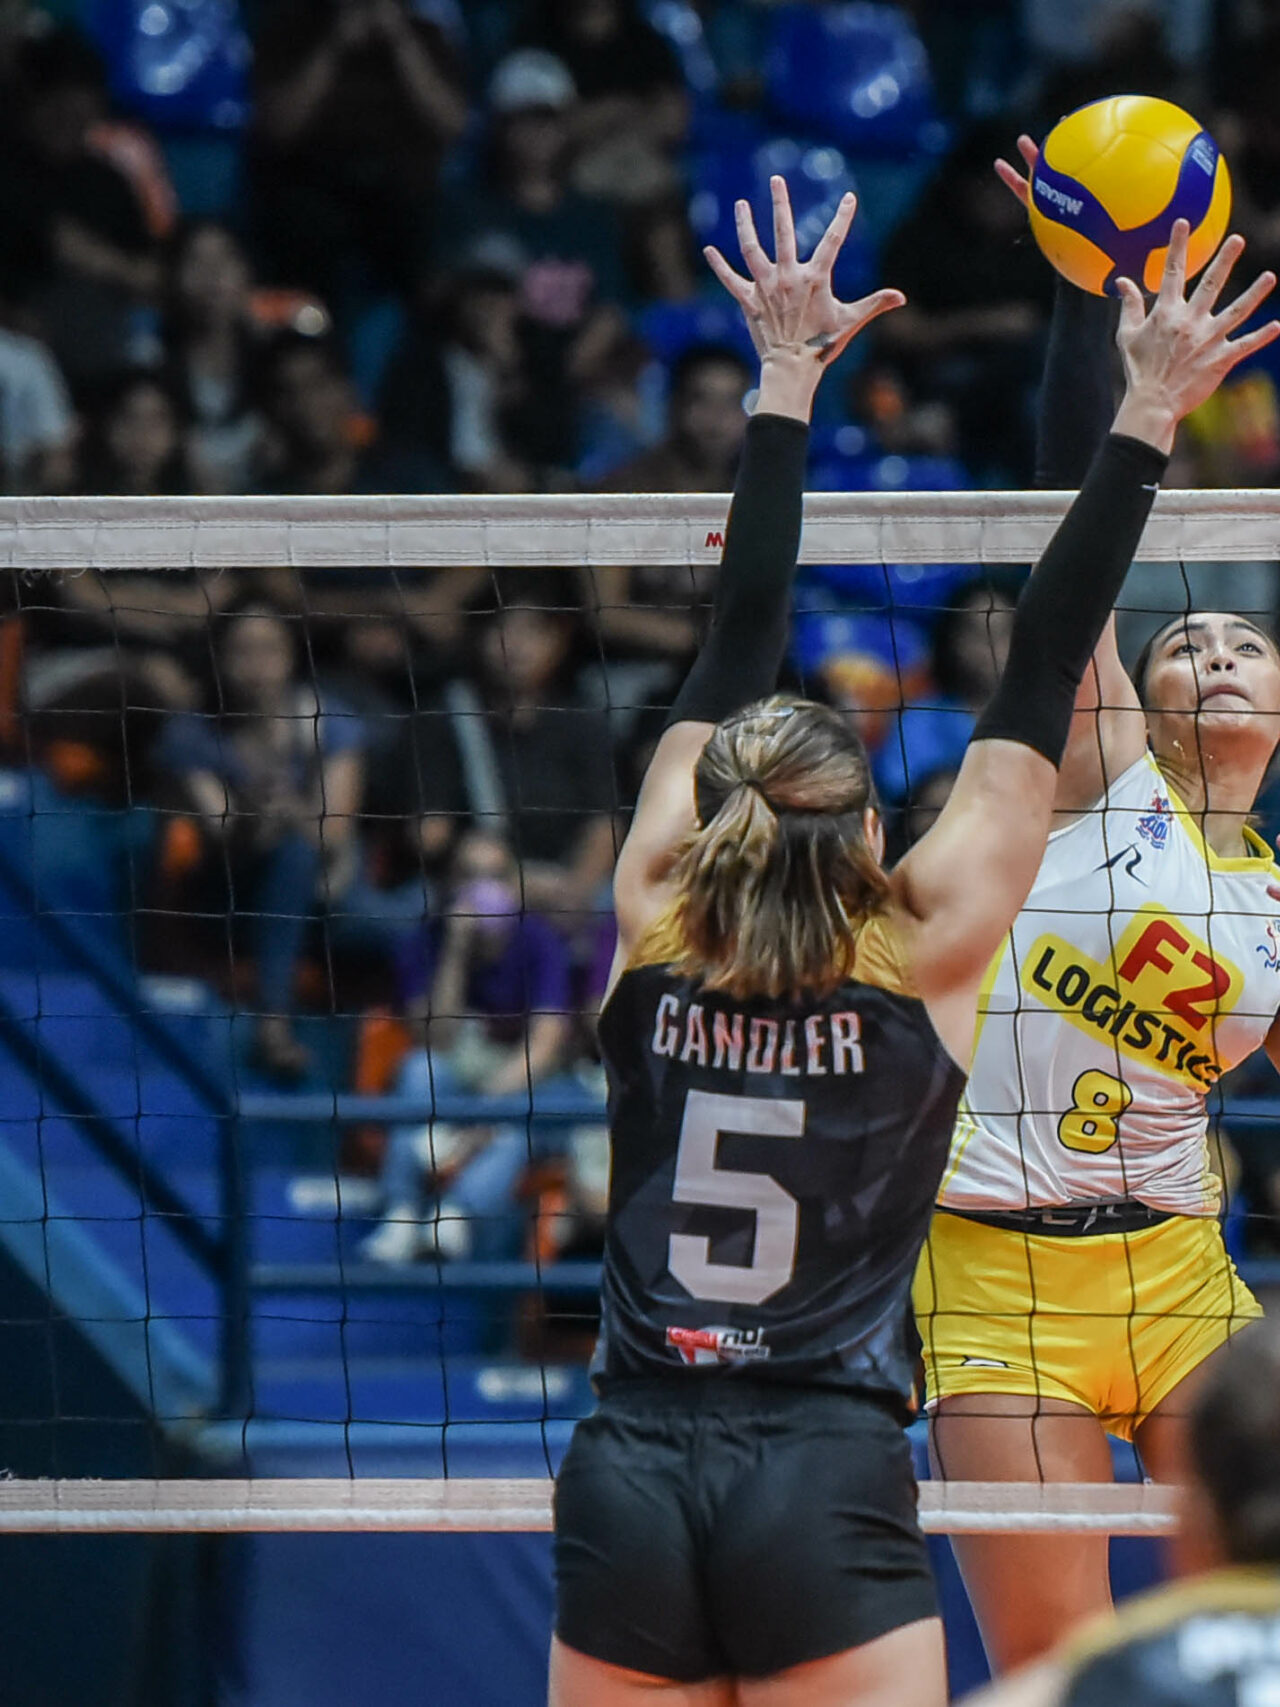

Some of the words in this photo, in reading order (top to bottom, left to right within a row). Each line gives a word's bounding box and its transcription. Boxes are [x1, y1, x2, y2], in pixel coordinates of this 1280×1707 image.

[1118, 919, 1231, 1031] F2
[653, 993, 867, 1076] GANDLER
[1057, 1068, 1134, 1155] 8
[667, 1088, 806, 1305] 5
